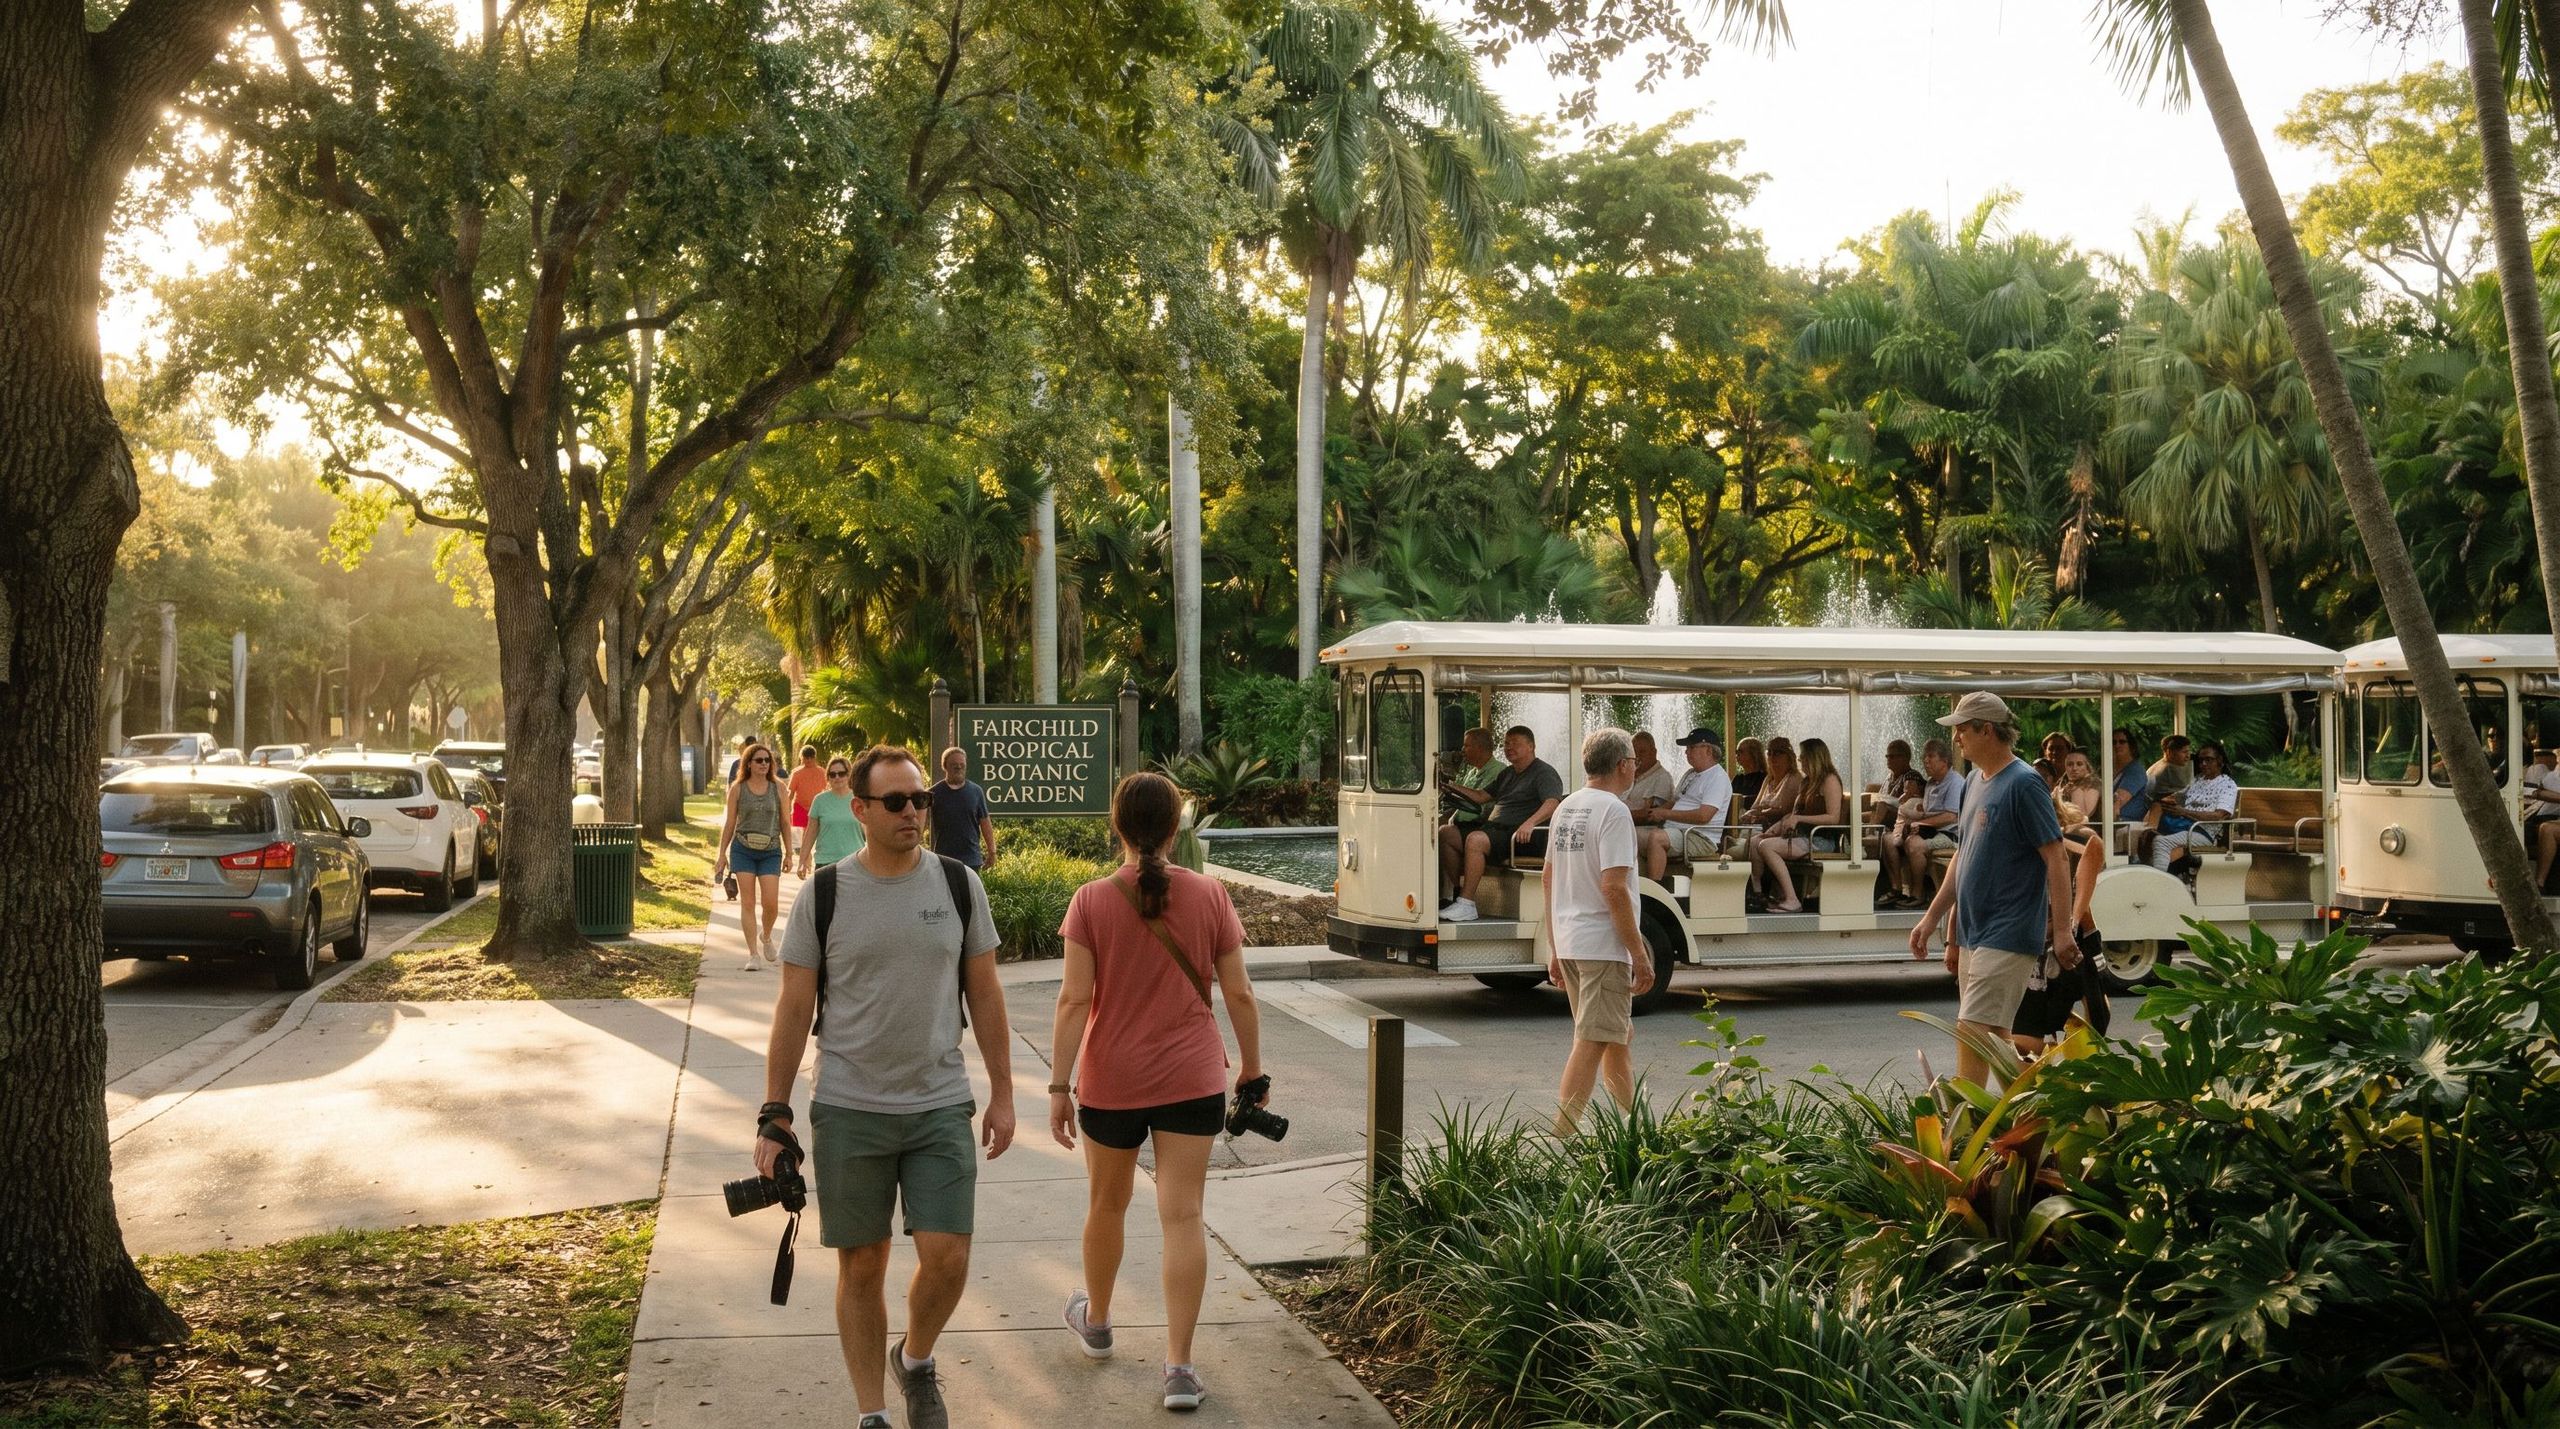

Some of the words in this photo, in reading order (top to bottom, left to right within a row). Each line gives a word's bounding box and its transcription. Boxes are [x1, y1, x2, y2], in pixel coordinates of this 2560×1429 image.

[972, 719, 1099, 737] FAIRCHILD
[976, 741, 1095, 759] TROPICAL
[983, 763, 1089, 781] BOTANIC
[985, 785, 1085, 803] GARDEN
